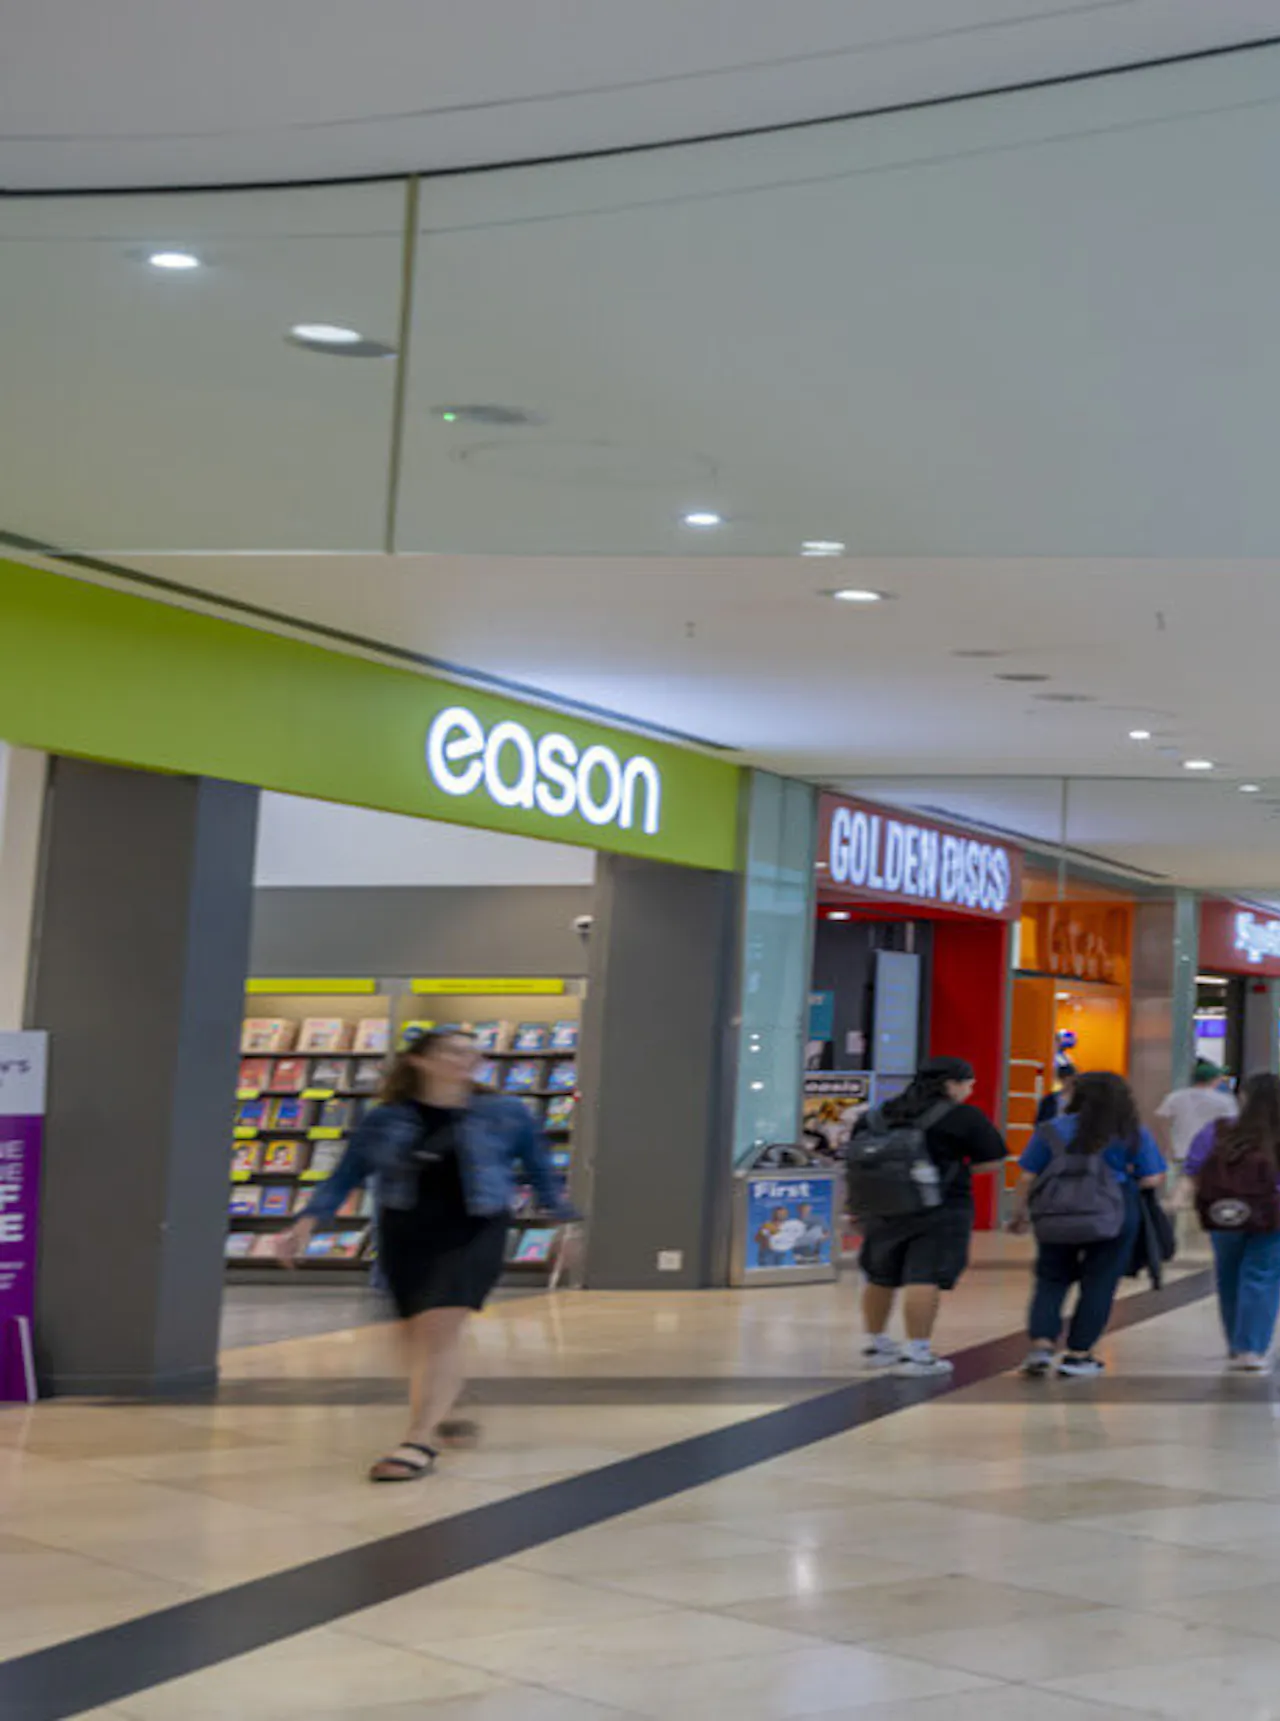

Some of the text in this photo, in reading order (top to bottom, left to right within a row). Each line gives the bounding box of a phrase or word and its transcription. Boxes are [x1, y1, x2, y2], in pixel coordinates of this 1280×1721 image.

[427, 706, 661, 834] eason
[829, 806, 1011, 913] GOLDEN DISCS
[753, 1182, 810, 1199] First
